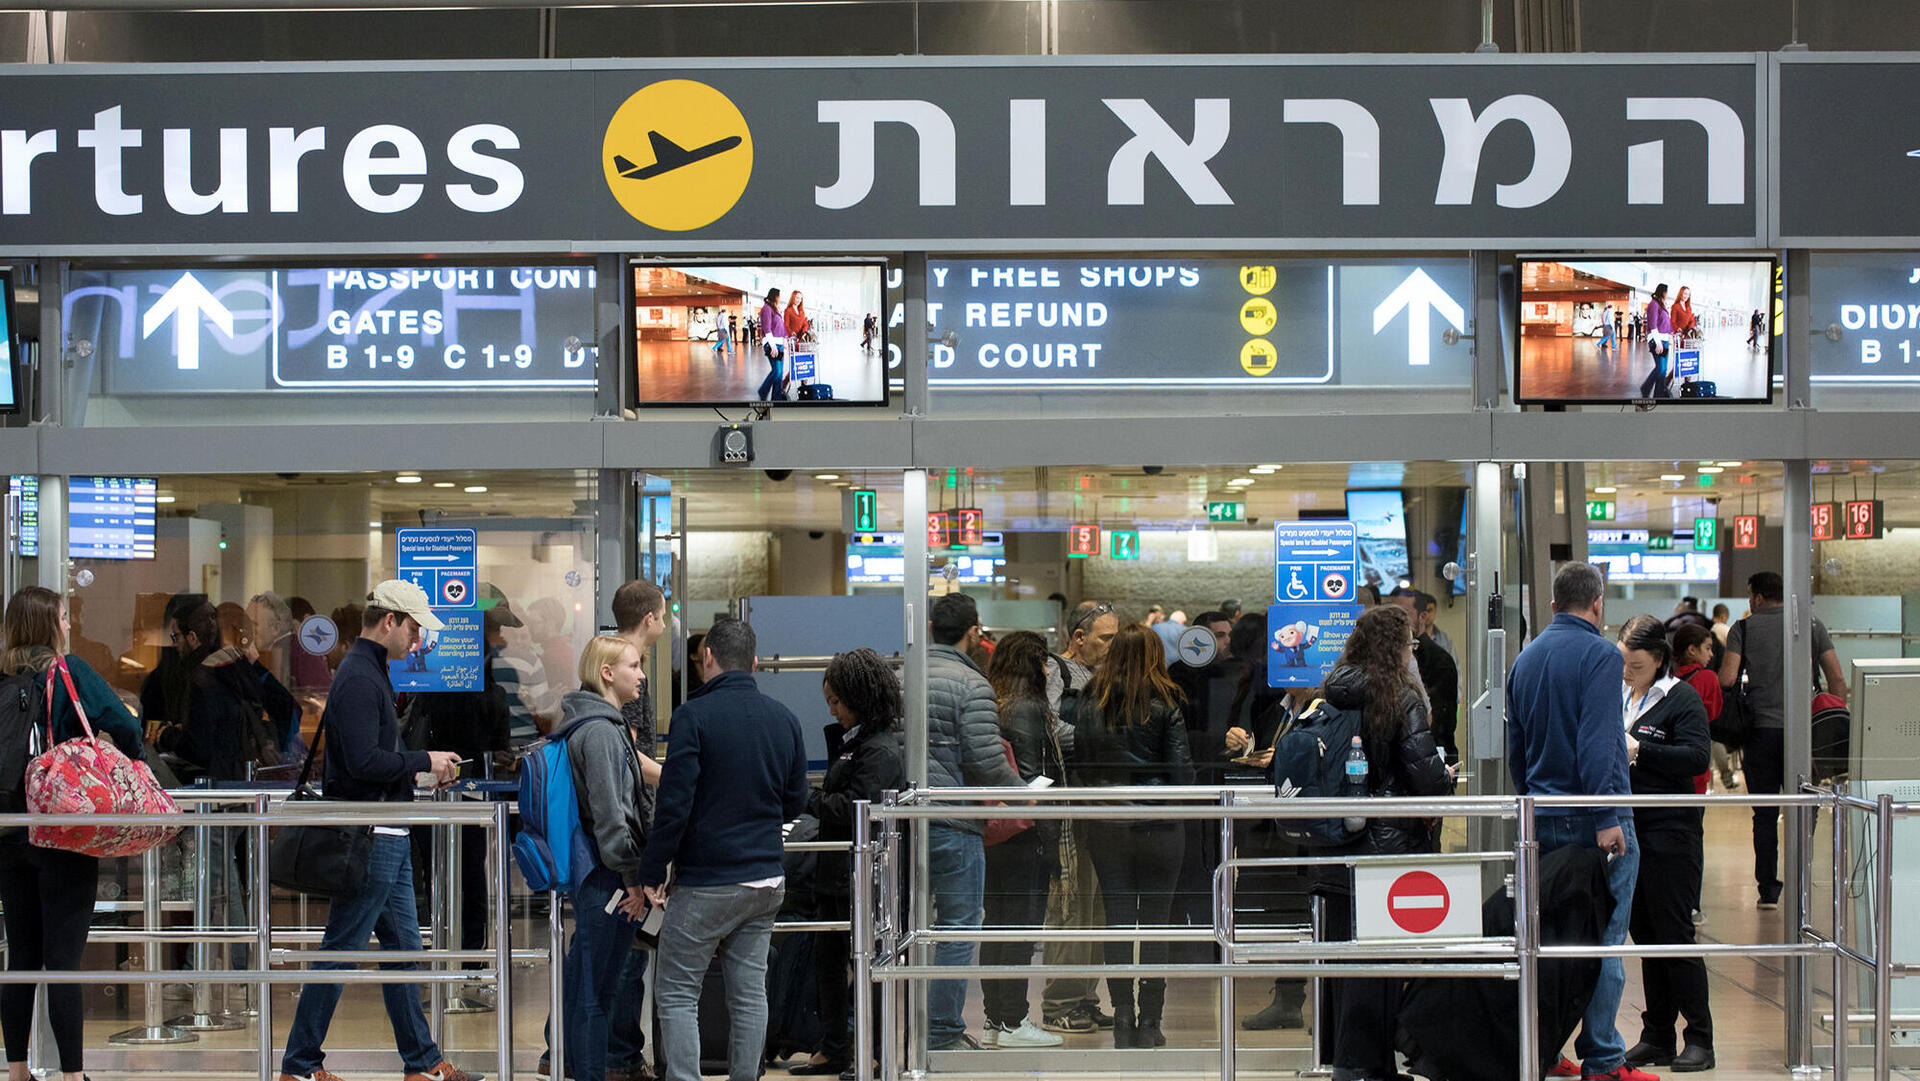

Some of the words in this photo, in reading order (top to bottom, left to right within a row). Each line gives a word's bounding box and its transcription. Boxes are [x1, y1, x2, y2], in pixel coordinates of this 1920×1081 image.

[1, 104, 525, 216] rtures
[814, 94, 1745, 210] המראות
[327, 269, 495, 290] PASSPORT
[971, 267, 1060, 288] FREE
[1080, 266, 1200, 288] SHOPS
[327, 310, 443, 335] GATES
[966, 302, 1108, 327] REFUND
[327, 345, 348, 369] B
[364, 345, 415, 369] 1-9
[444, 344, 466, 369] C
[482, 344, 533, 369] 1-9
[978, 343, 1102, 368] COURT
[1861, 339, 1882, 363] B
[861, 494, 869, 514] 1
[1851, 504, 1869, 523] 16
[928, 516, 940, 532] 3
[965, 512, 975, 529] 2
[1811, 507, 1829, 525] 15
[1079, 528, 1090, 542] 5
[1698, 521, 1712, 537] 13
[1738, 519, 1753, 535] 14
[1119, 534, 1130, 548] 7
[438, 650, 464, 658] boarding
[439, 643, 466, 651] passport
